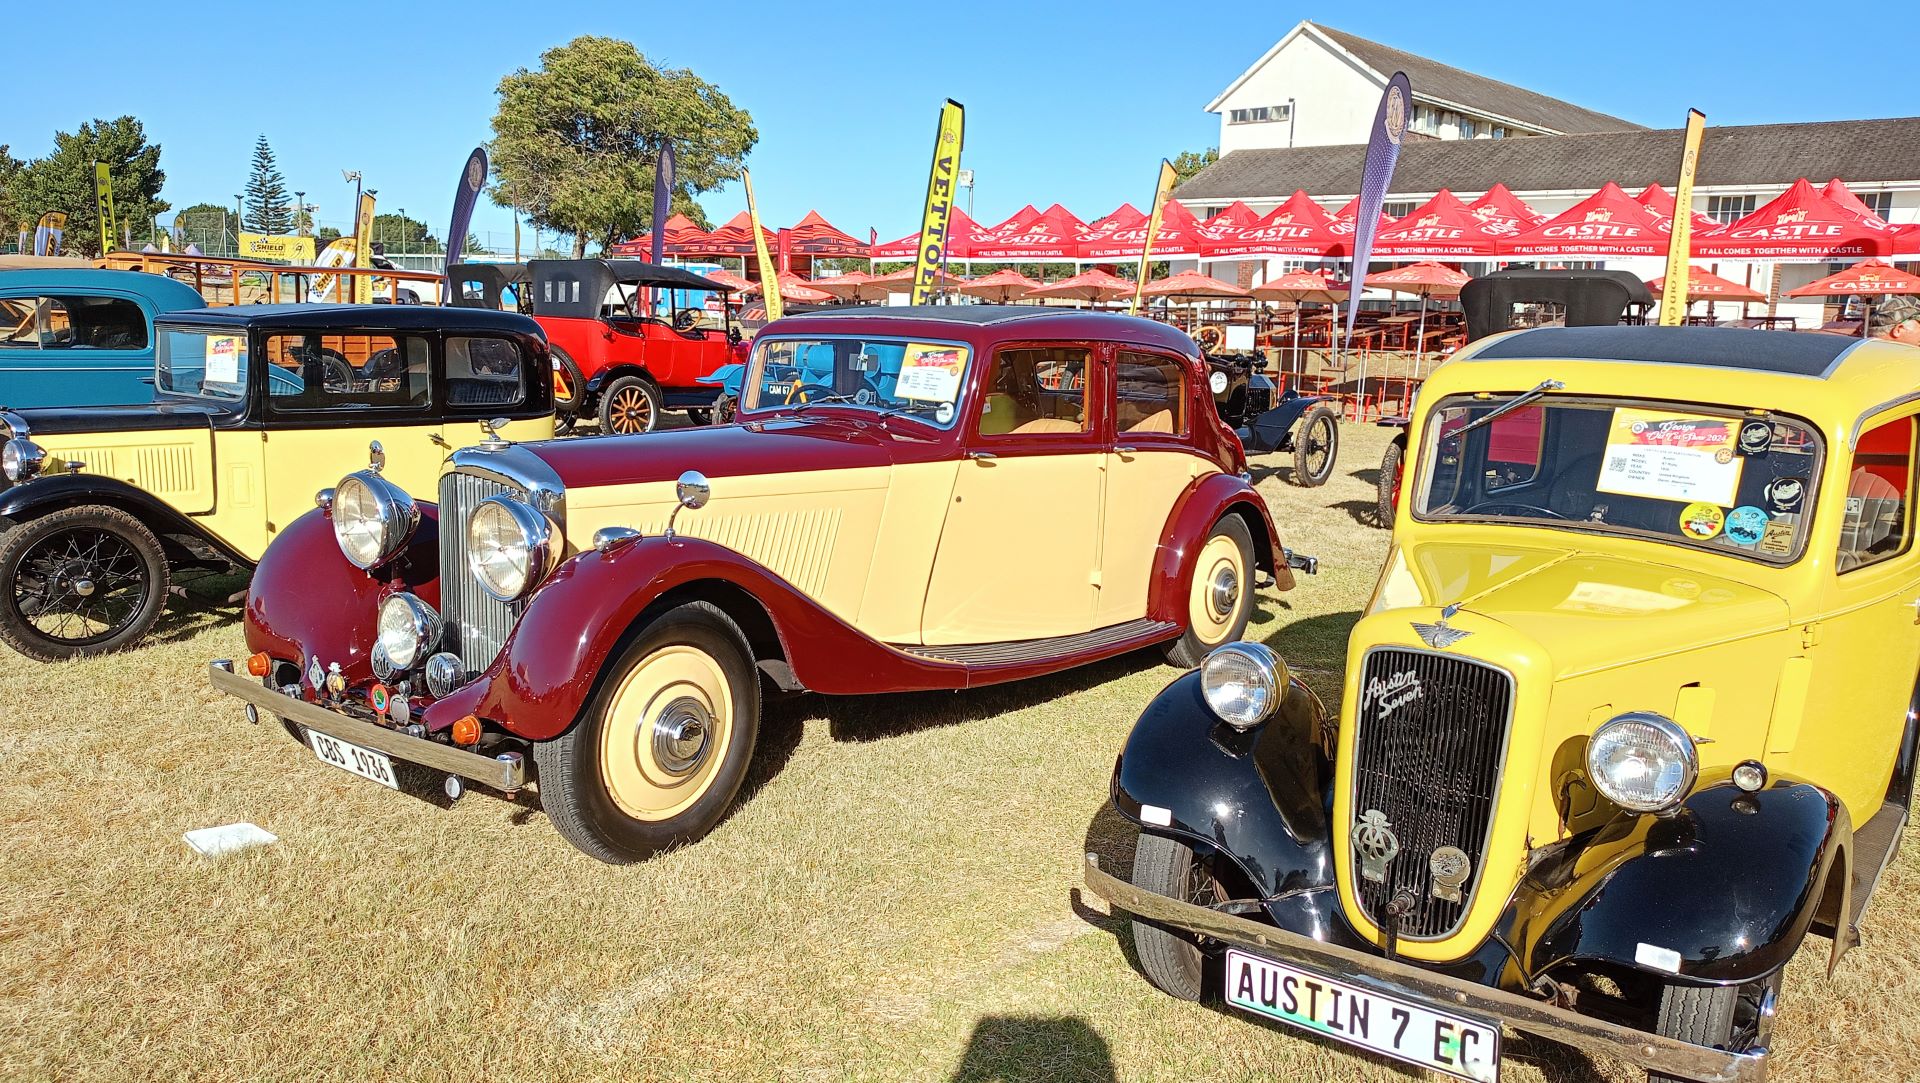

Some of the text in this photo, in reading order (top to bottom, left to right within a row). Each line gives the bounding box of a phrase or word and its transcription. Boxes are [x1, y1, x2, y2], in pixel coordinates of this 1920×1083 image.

[1112, 230, 1181, 240] CASLE
[1237, 227, 1313, 239] CASTLE
[1378, 228, 1464, 240] CASTLE
[1543, 224, 1641, 237] CASTLE
[1730, 225, 1844, 238] CASTLE
[999, 234, 1062, 244] CASTLE
[256, 244, 284, 252] SHIELD
[1699, 247, 1708, 255] IT
[1708, 247, 1723, 255] ALL
[1723, 247, 1751, 255] COMES
[1830, 246, 1864, 254] CASTLE.
[1829, 281, 1908, 289] CASTLE
[769, 385, 781, 395] CAM
[1658, 421, 1697, 434] George
[1706, 434, 1727, 442] 2024
[1364, 670, 1420, 711] Austin
[1378, 686, 1424, 720] Seven
[316, 735, 390, 782] CBS 1936
[1237, 962, 1480, 1074] AUSTIN 7 EC
